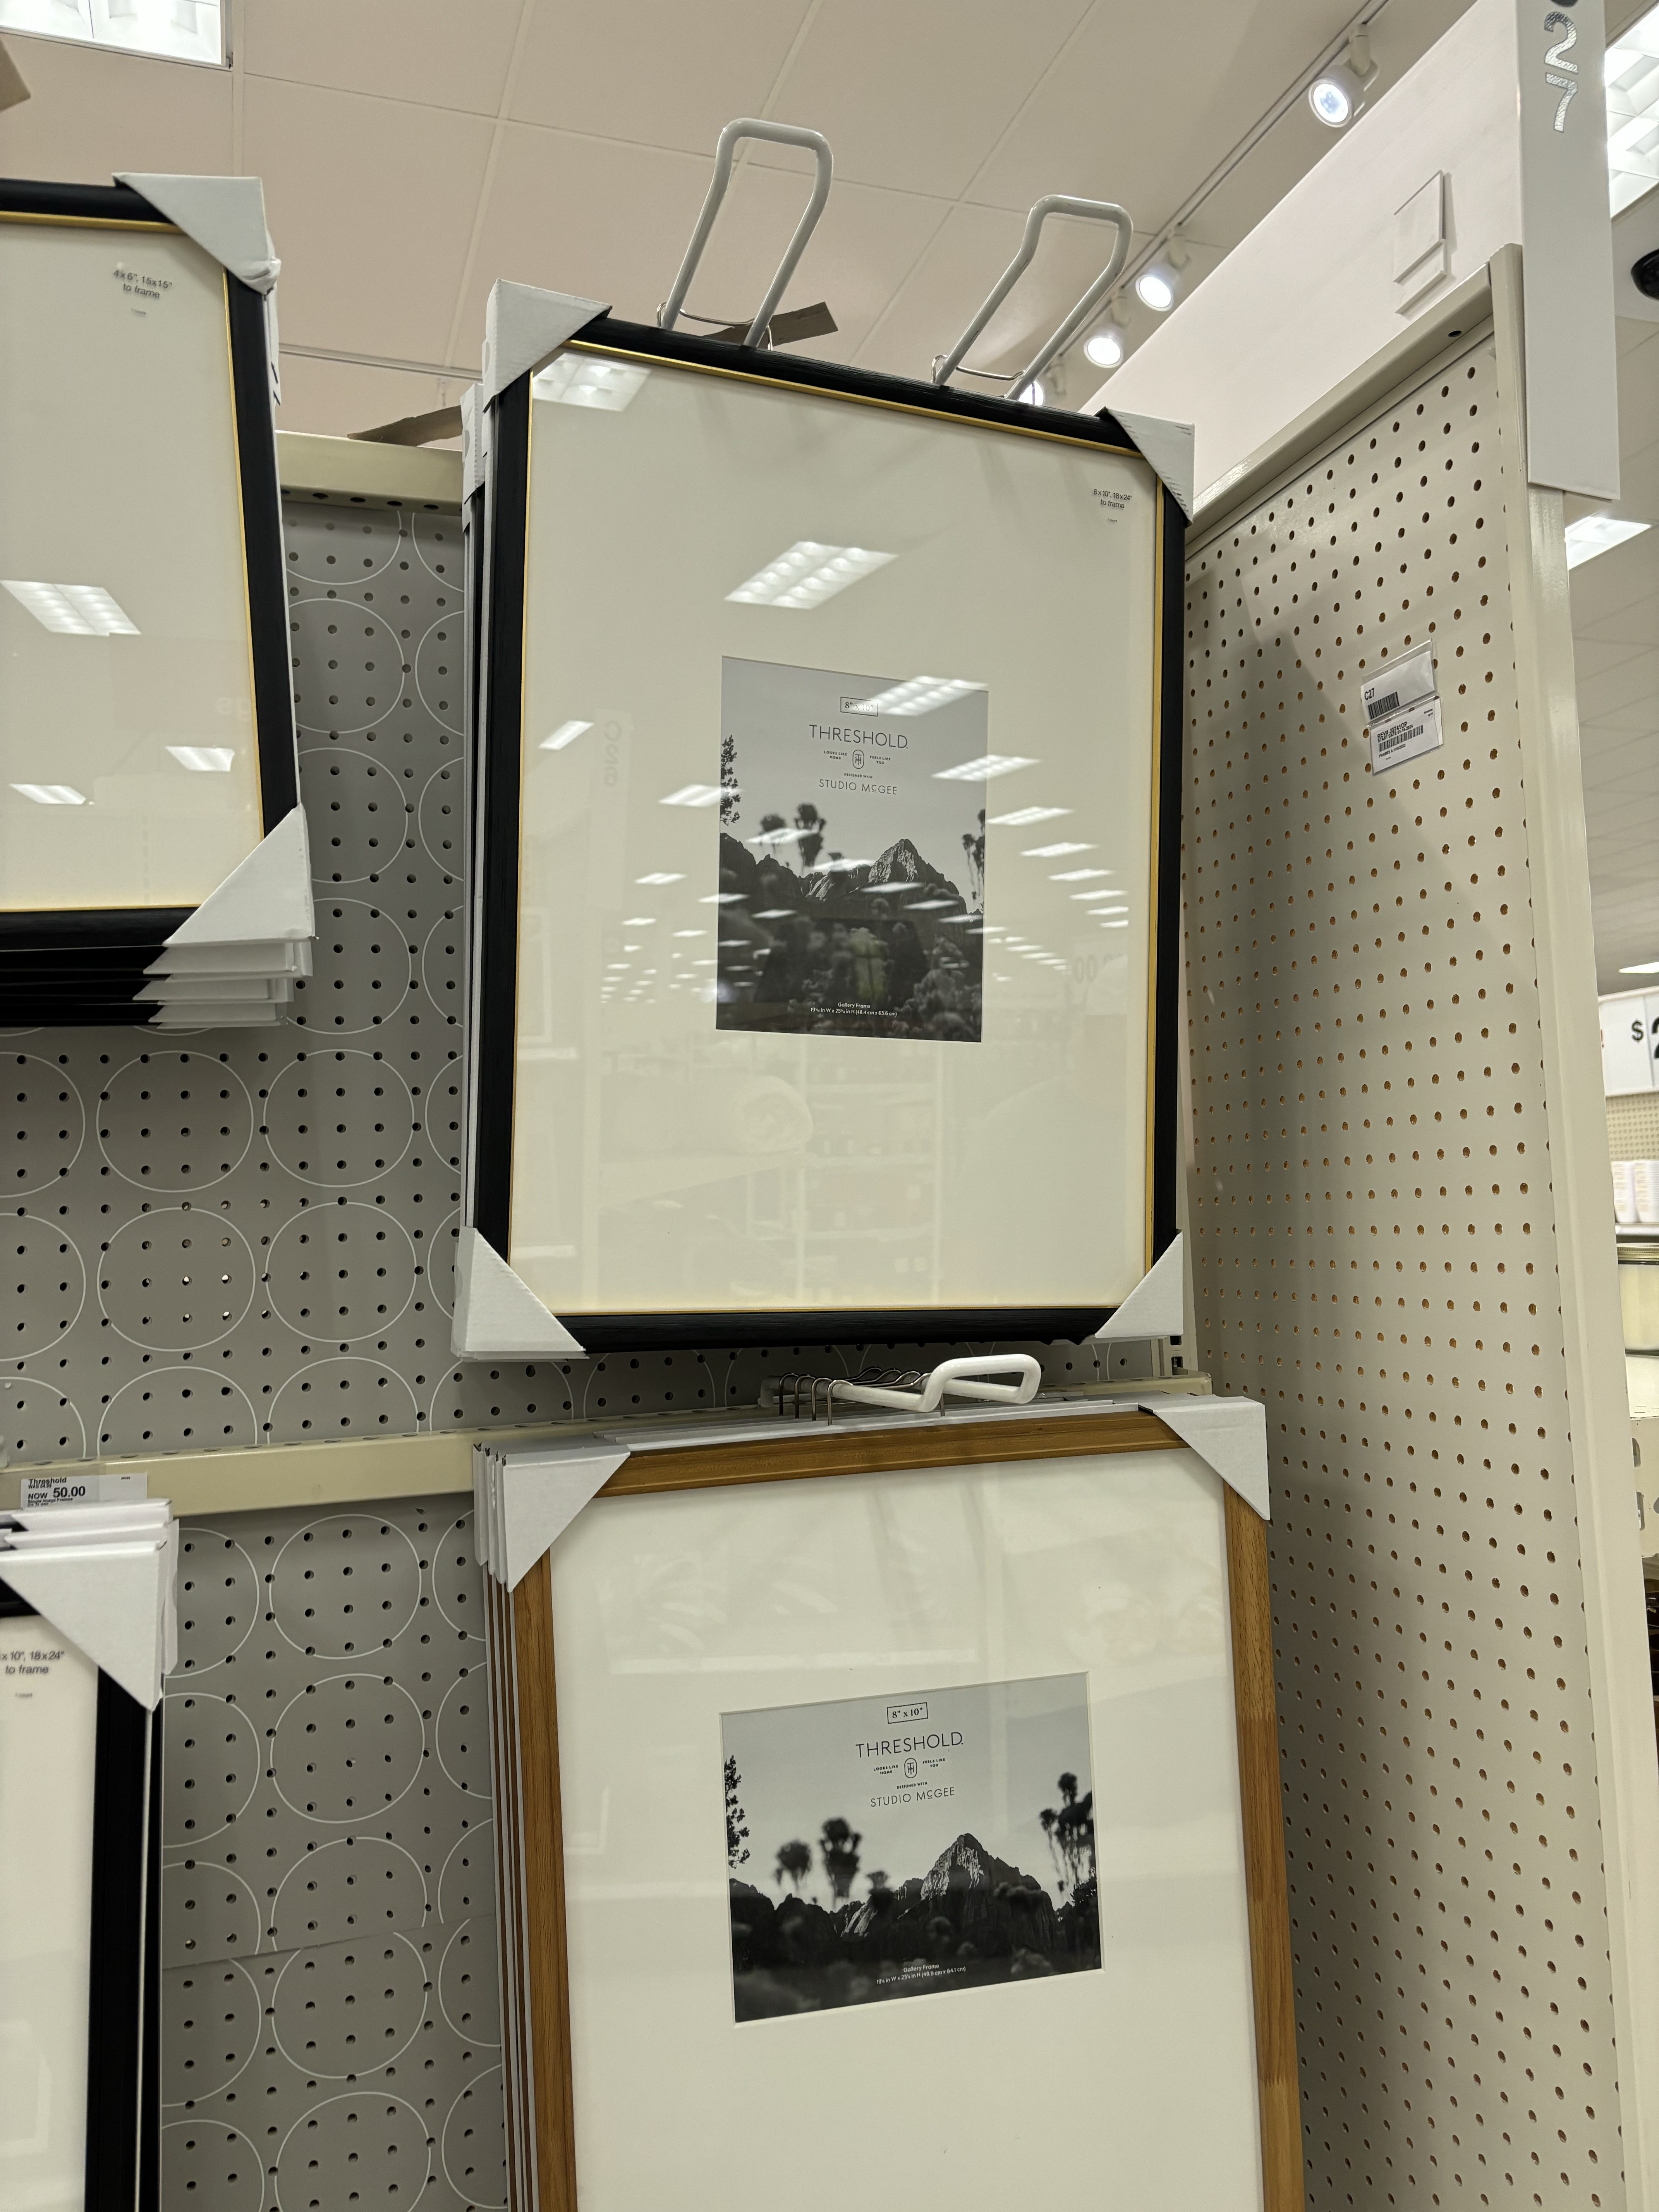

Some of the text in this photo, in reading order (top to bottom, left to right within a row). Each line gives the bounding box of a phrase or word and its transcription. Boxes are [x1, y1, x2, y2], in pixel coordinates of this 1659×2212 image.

[1544, 0, 1578, 133] 27
[135, 286, 160, 298] frame
[1108, 500, 1125, 509] frame
[1364, 688, 1374, 700] C27
[819, 779, 857, 790] STUDIO
[53, 1486, 86, 1498] 50.00
[5, 1664, 49, 1674] to frame
[910, 1707, 923, 1716] 10"
[871, 1793, 911, 1807] STUDIO
